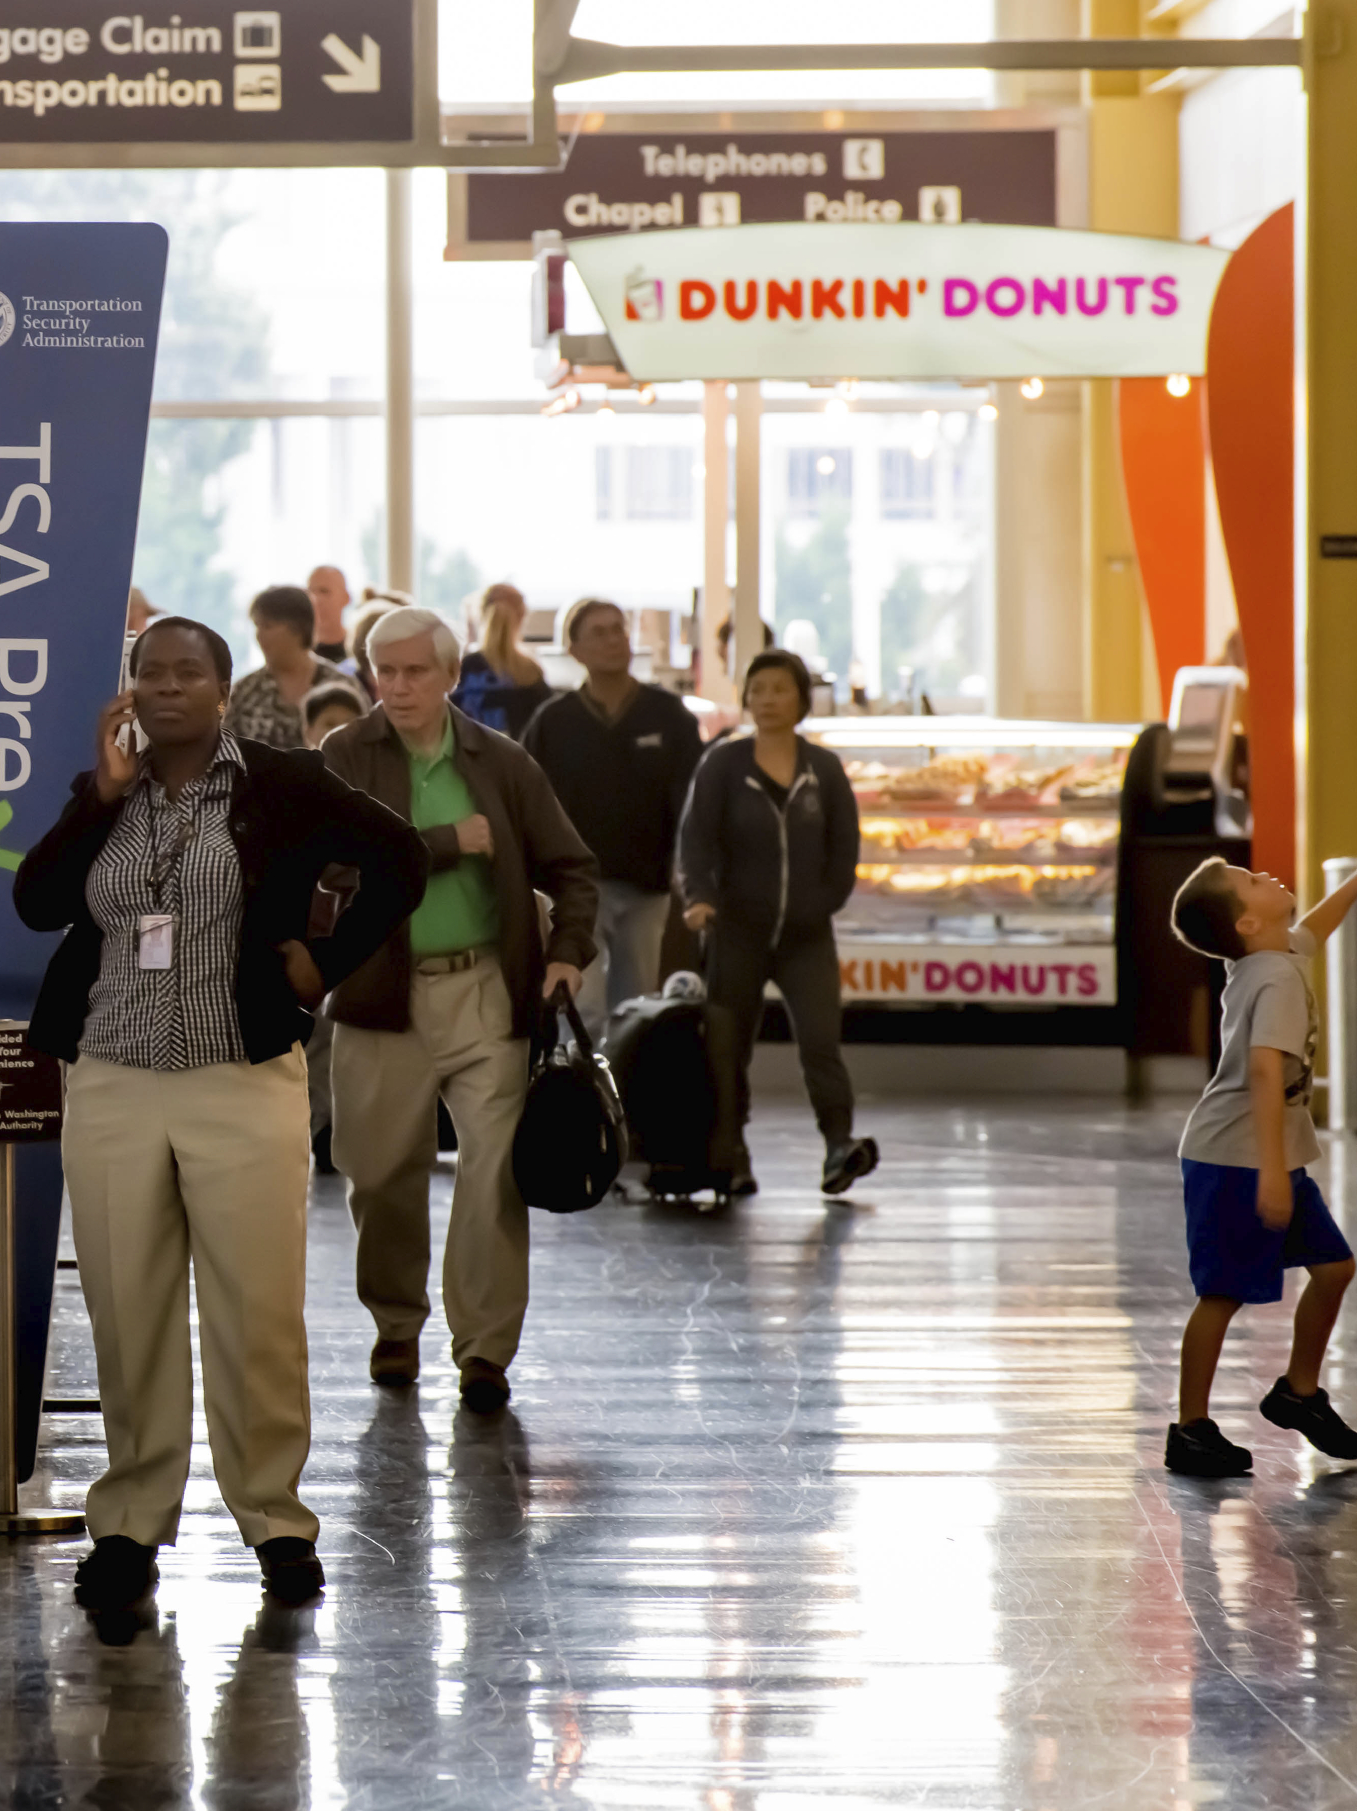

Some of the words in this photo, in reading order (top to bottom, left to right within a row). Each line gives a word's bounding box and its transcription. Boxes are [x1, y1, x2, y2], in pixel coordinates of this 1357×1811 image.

[100, 16, 223, 54] Claim
[640, 143, 827, 183] Telephones
[563, 192, 684, 231] Chapel
[803, 190, 903, 222] Police
[22, 296, 143, 315] Transportation
[678, 278, 927, 321] DUNKIN'
[943, 275, 1180, 318] DONUTS
[22, 315, 91, 333] Security
[22, 332, 145, 348] Administration
[840, 959, 919, 993] KIN'
[924, 961, 1099, 996] DONUTS
[0, 1121, 43, 1131] Authority
[4, 1109, 60, 1120] Washington
